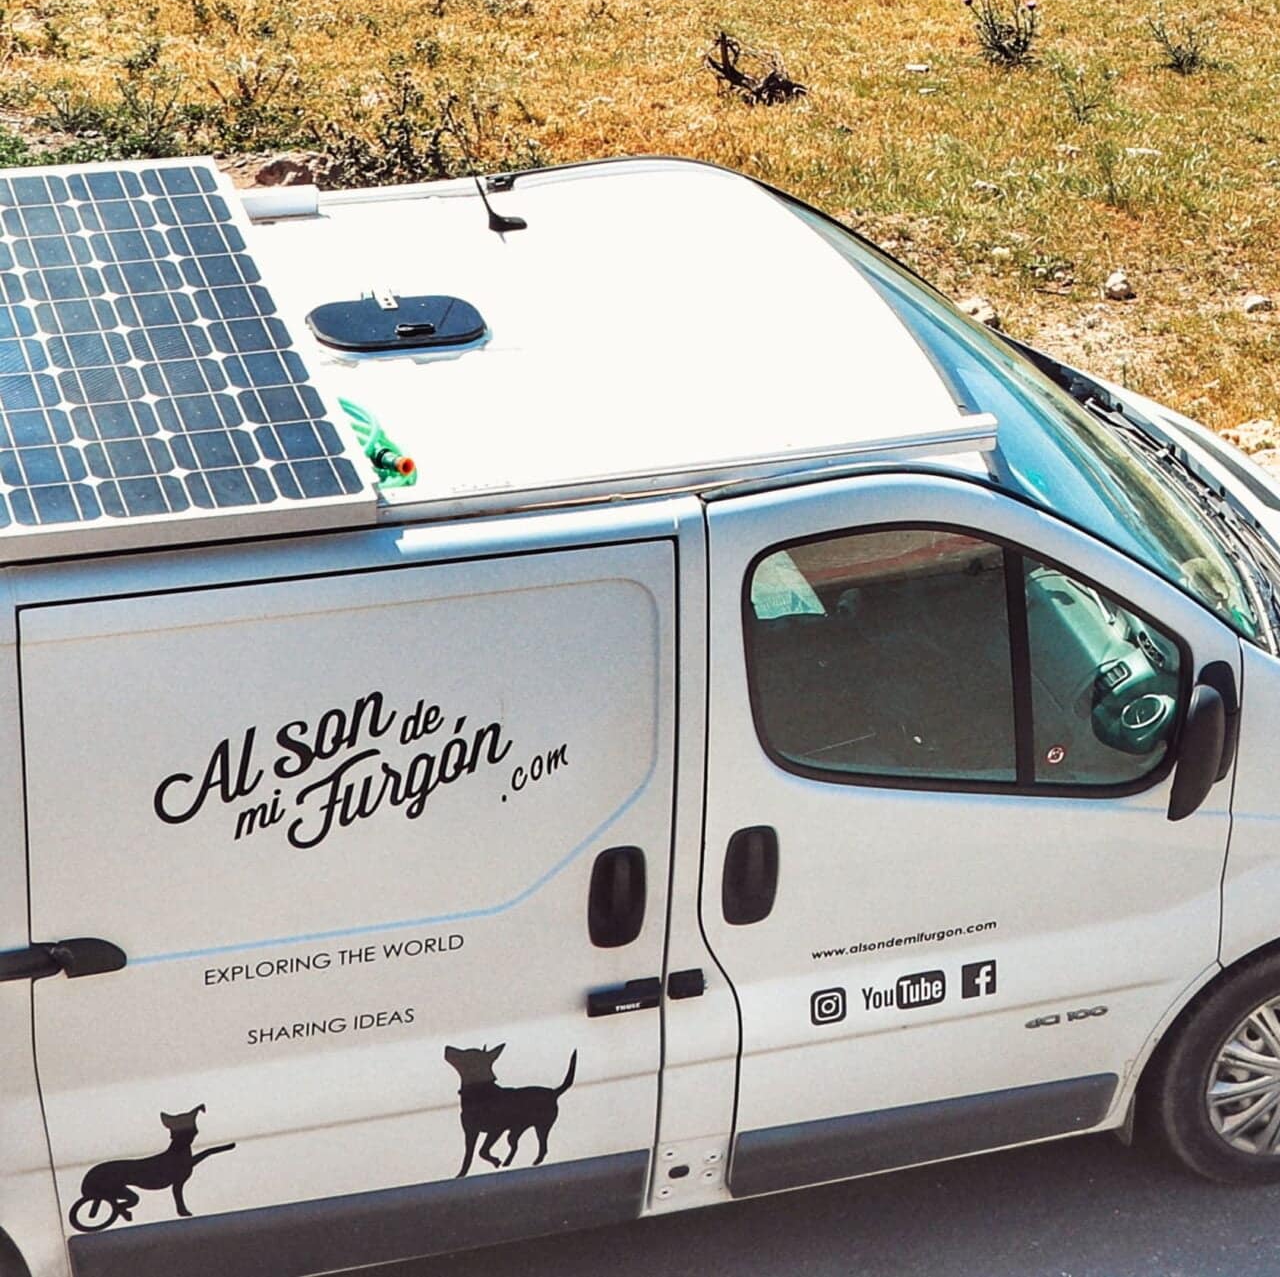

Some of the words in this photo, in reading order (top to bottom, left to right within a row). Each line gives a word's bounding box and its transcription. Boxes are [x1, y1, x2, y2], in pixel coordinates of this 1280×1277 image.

[154, 726, 264, 825] Al
[399, 698, 445, 746] de
[234, 788, 286, 841] mi
[287, 715, 513, 850] Furgón
[204, 952, 332, 986] EXPLORING
[338, 945, 377, 966] THE
[383, 934, 465, 959] WORLD
[811, 920, 997, 960] www.alsondemifurgon.com
[861, 972, 945, 1011] YouTube
[247, 1017, 348, 1045] SHARING
[353, 1007, 416, 1031] IDEAS
[1066, 1005, 1109, 1022] 100
